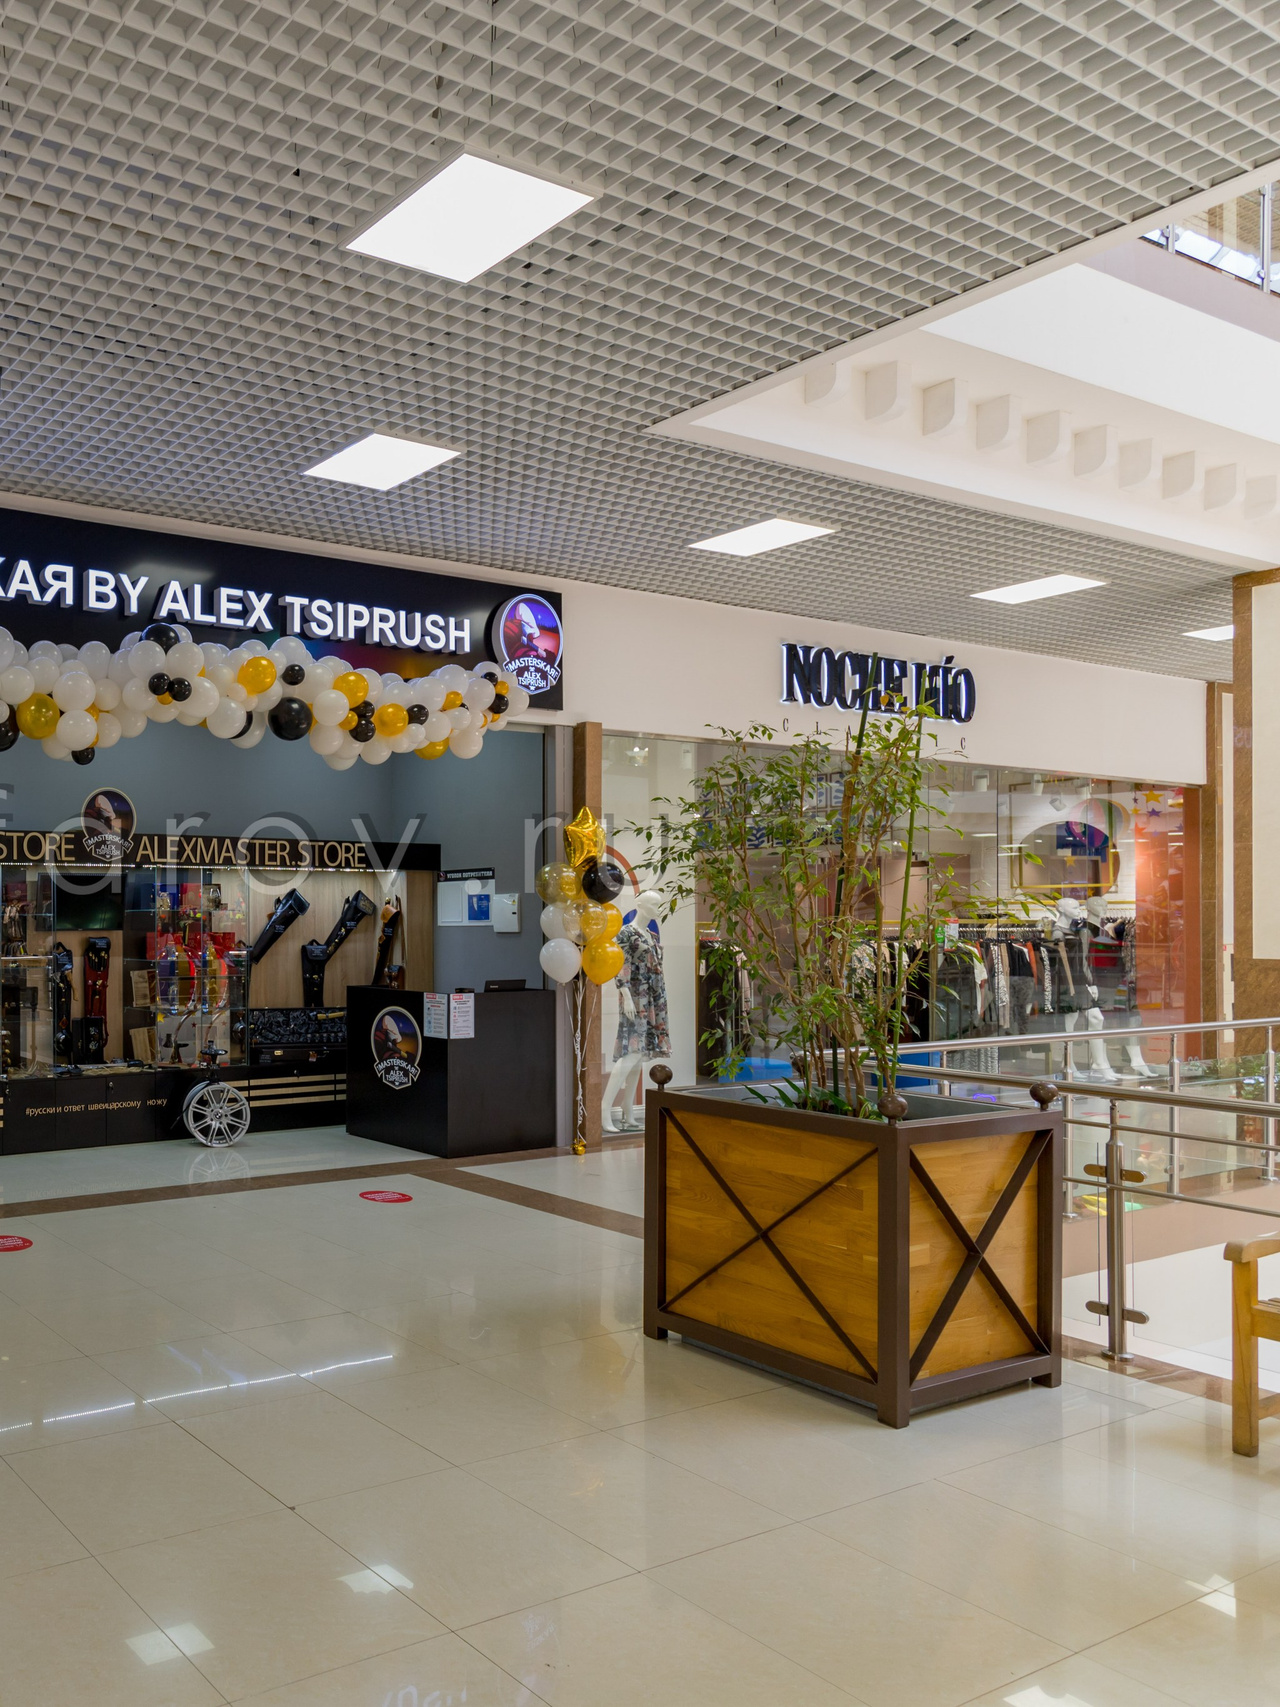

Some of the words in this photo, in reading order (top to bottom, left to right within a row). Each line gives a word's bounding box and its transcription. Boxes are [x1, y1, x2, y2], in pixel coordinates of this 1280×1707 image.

[84, 569, 148, 616] BY
[159, 580, 273, 632] ALEX
[286, 596, 471, 654] TSIPRUSH
[523, 671, 542, 680] ALEX
[782, 643, 908, 714] NOCHE
[783, 717, 966, 750] CLAIC
[136, 835, 367, 868] ALEXMASTER.STORE
[63, 1105, 85, 1113] ответ
[147, 1098, 167, 1107] ножу
